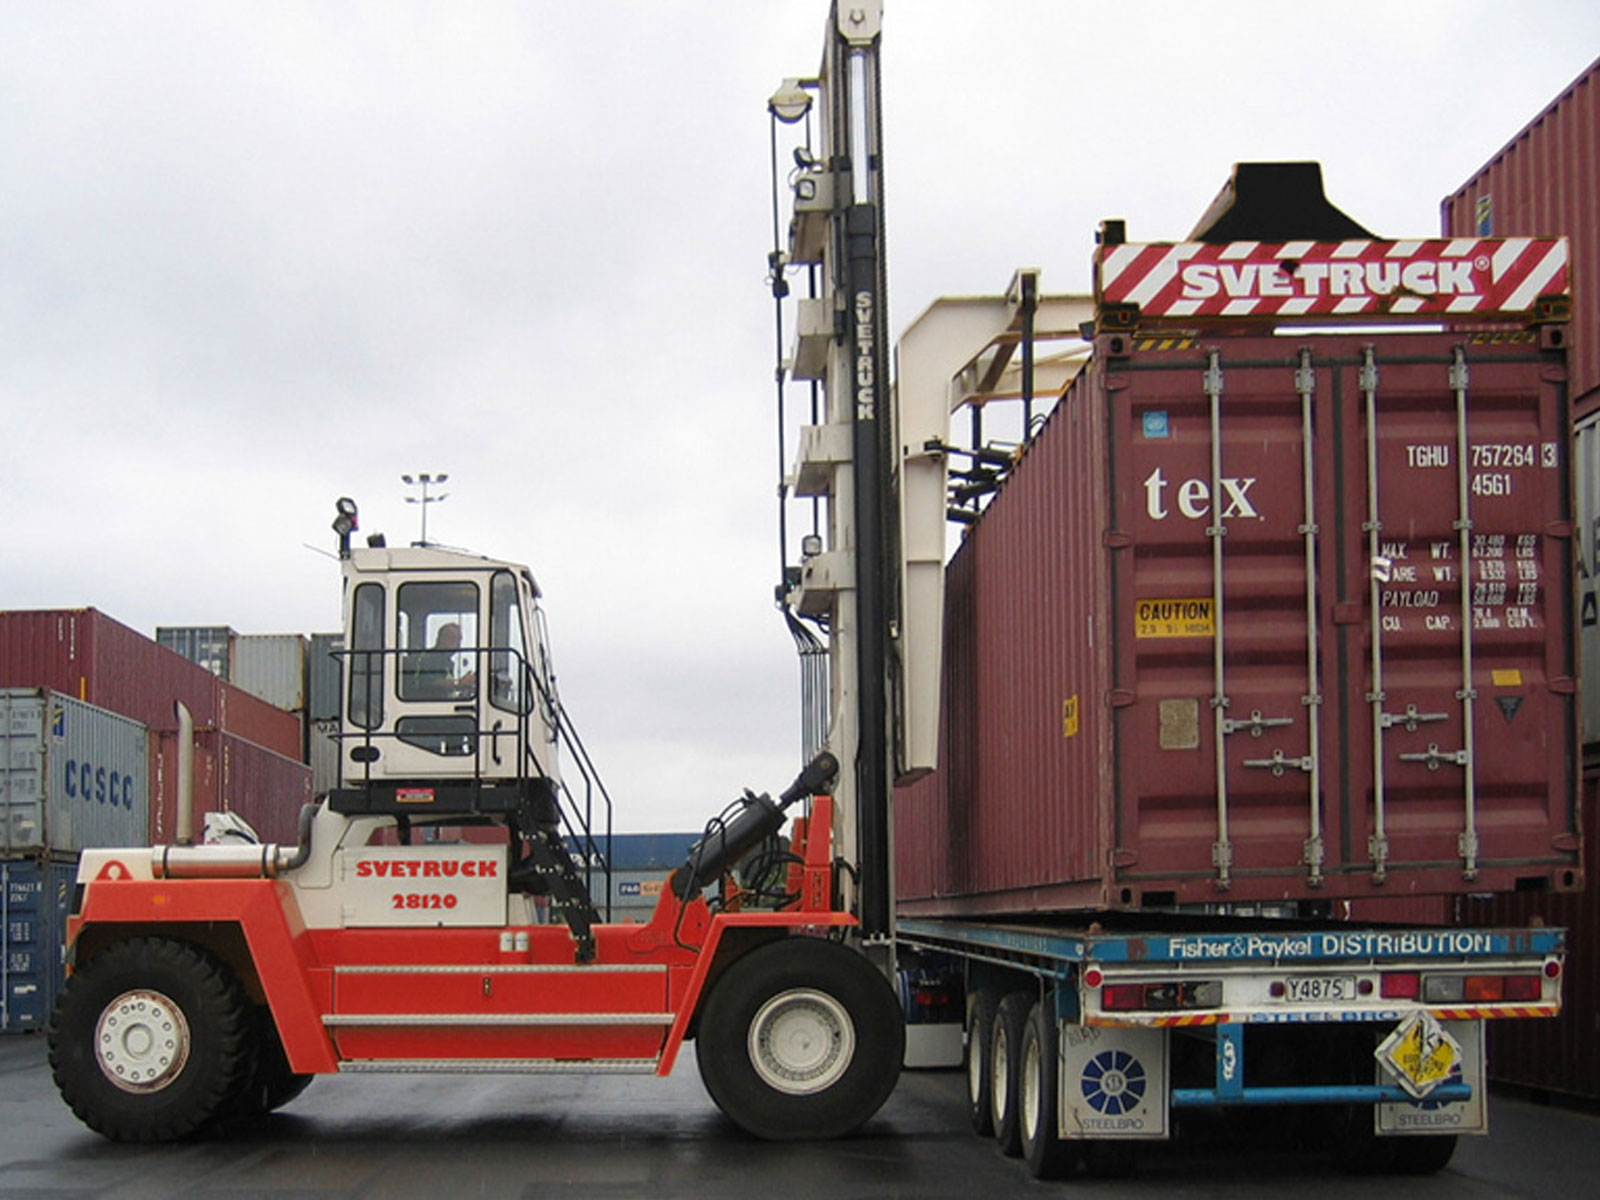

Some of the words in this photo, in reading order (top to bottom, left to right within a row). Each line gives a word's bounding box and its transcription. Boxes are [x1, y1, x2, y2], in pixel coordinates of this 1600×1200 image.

[856, 291, 875, 420] SVETRUCK
[1406, 445, 1449, 467] TGHU
[1471, 444, 1534, 467] 757264
[1542, 443, 1557, 467] 3
[1471, 474, 1512, 495] 45G1
[1382, 591, 1438, 608] PAYLOAD
[1140, 602, 1210, 621] CAUTION
[1425, 615, 1455, 631] CAP.
[356, 860, 498, 878] SVETRUCK
[392, 893, 458, 910] 28120
[1322, 933, 1491, 955] DISTRIBUTION
[1289, 980, 1343, 999] Y4875
[1082, 1118, 1144, 1130] STEELBRO
[1400, 1113, 1461, 1126] STEELBRO
